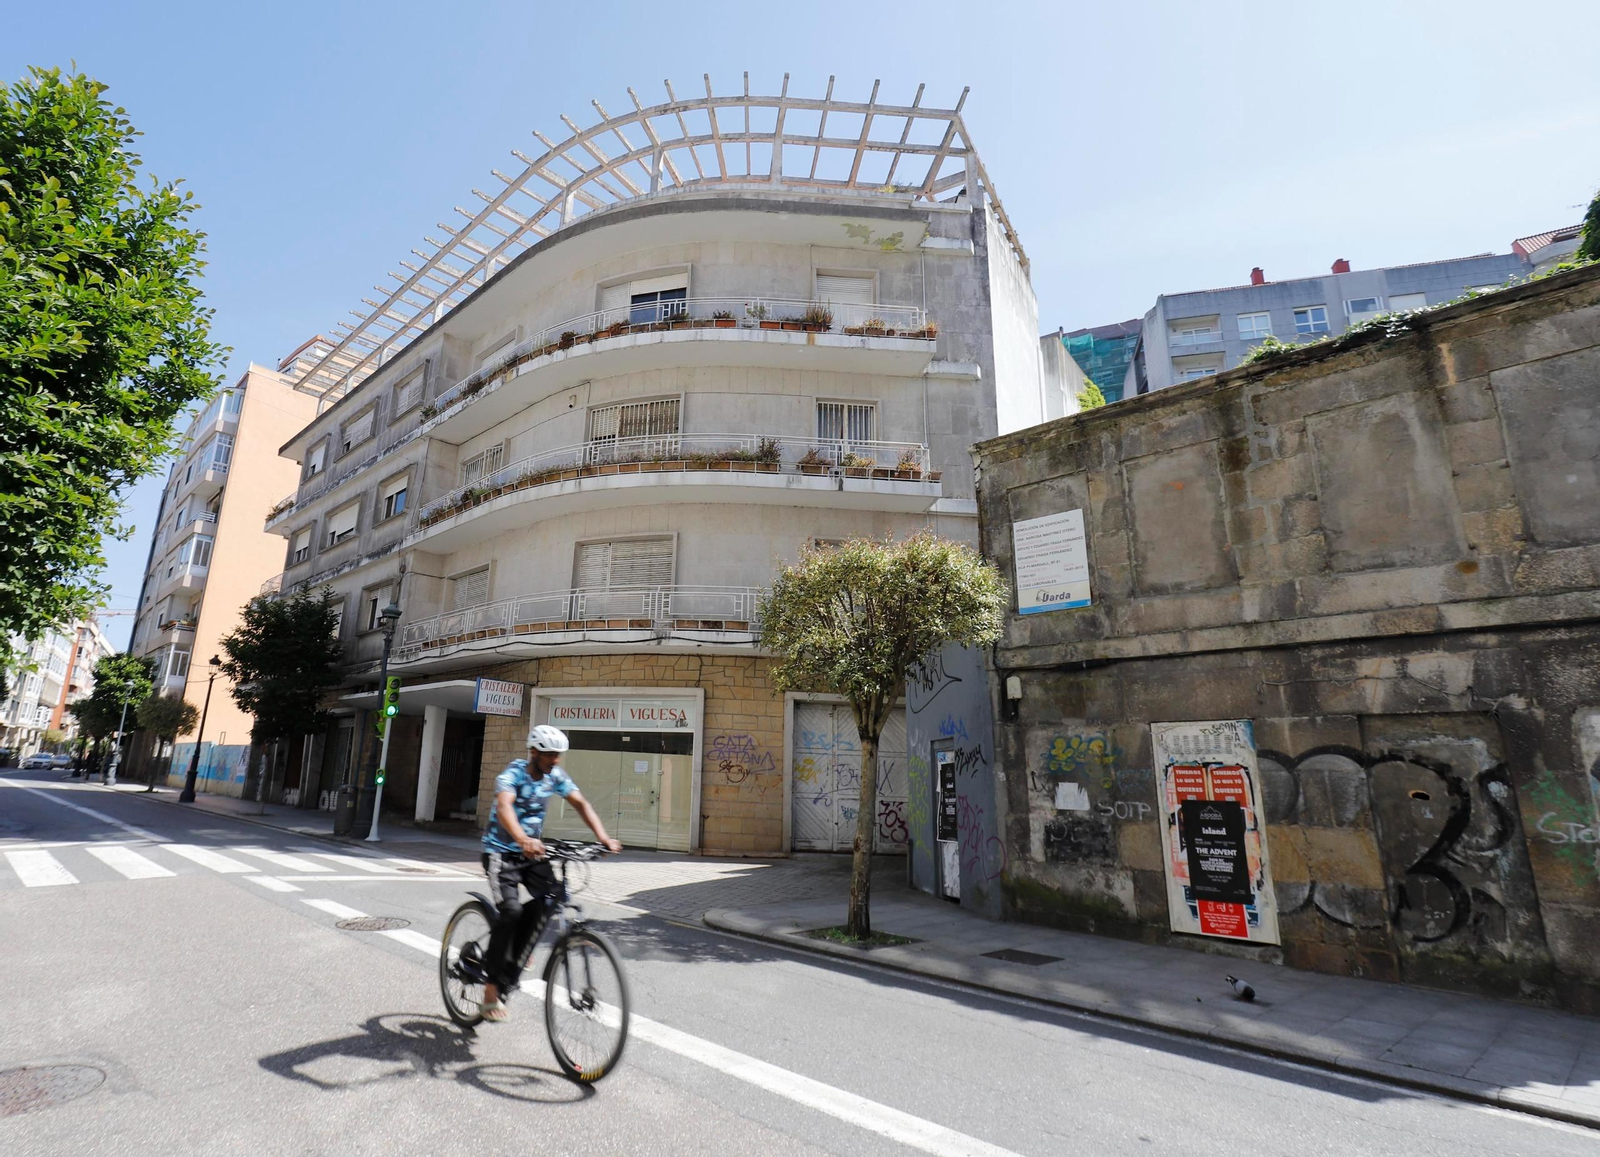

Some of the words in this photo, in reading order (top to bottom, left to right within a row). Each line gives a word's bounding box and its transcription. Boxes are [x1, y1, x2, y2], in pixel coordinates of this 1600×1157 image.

[480, 680, 523, 694] CRISTALERIA
[485, 693, 515, 706] VIGUESA
[554, 706, 616, 720] CRISTALERIA
[629, 707, 687, 720] VIGUESA
[713, 734, 756, 751] GATA
[1210, 848, 1237, 856] ADVENT
